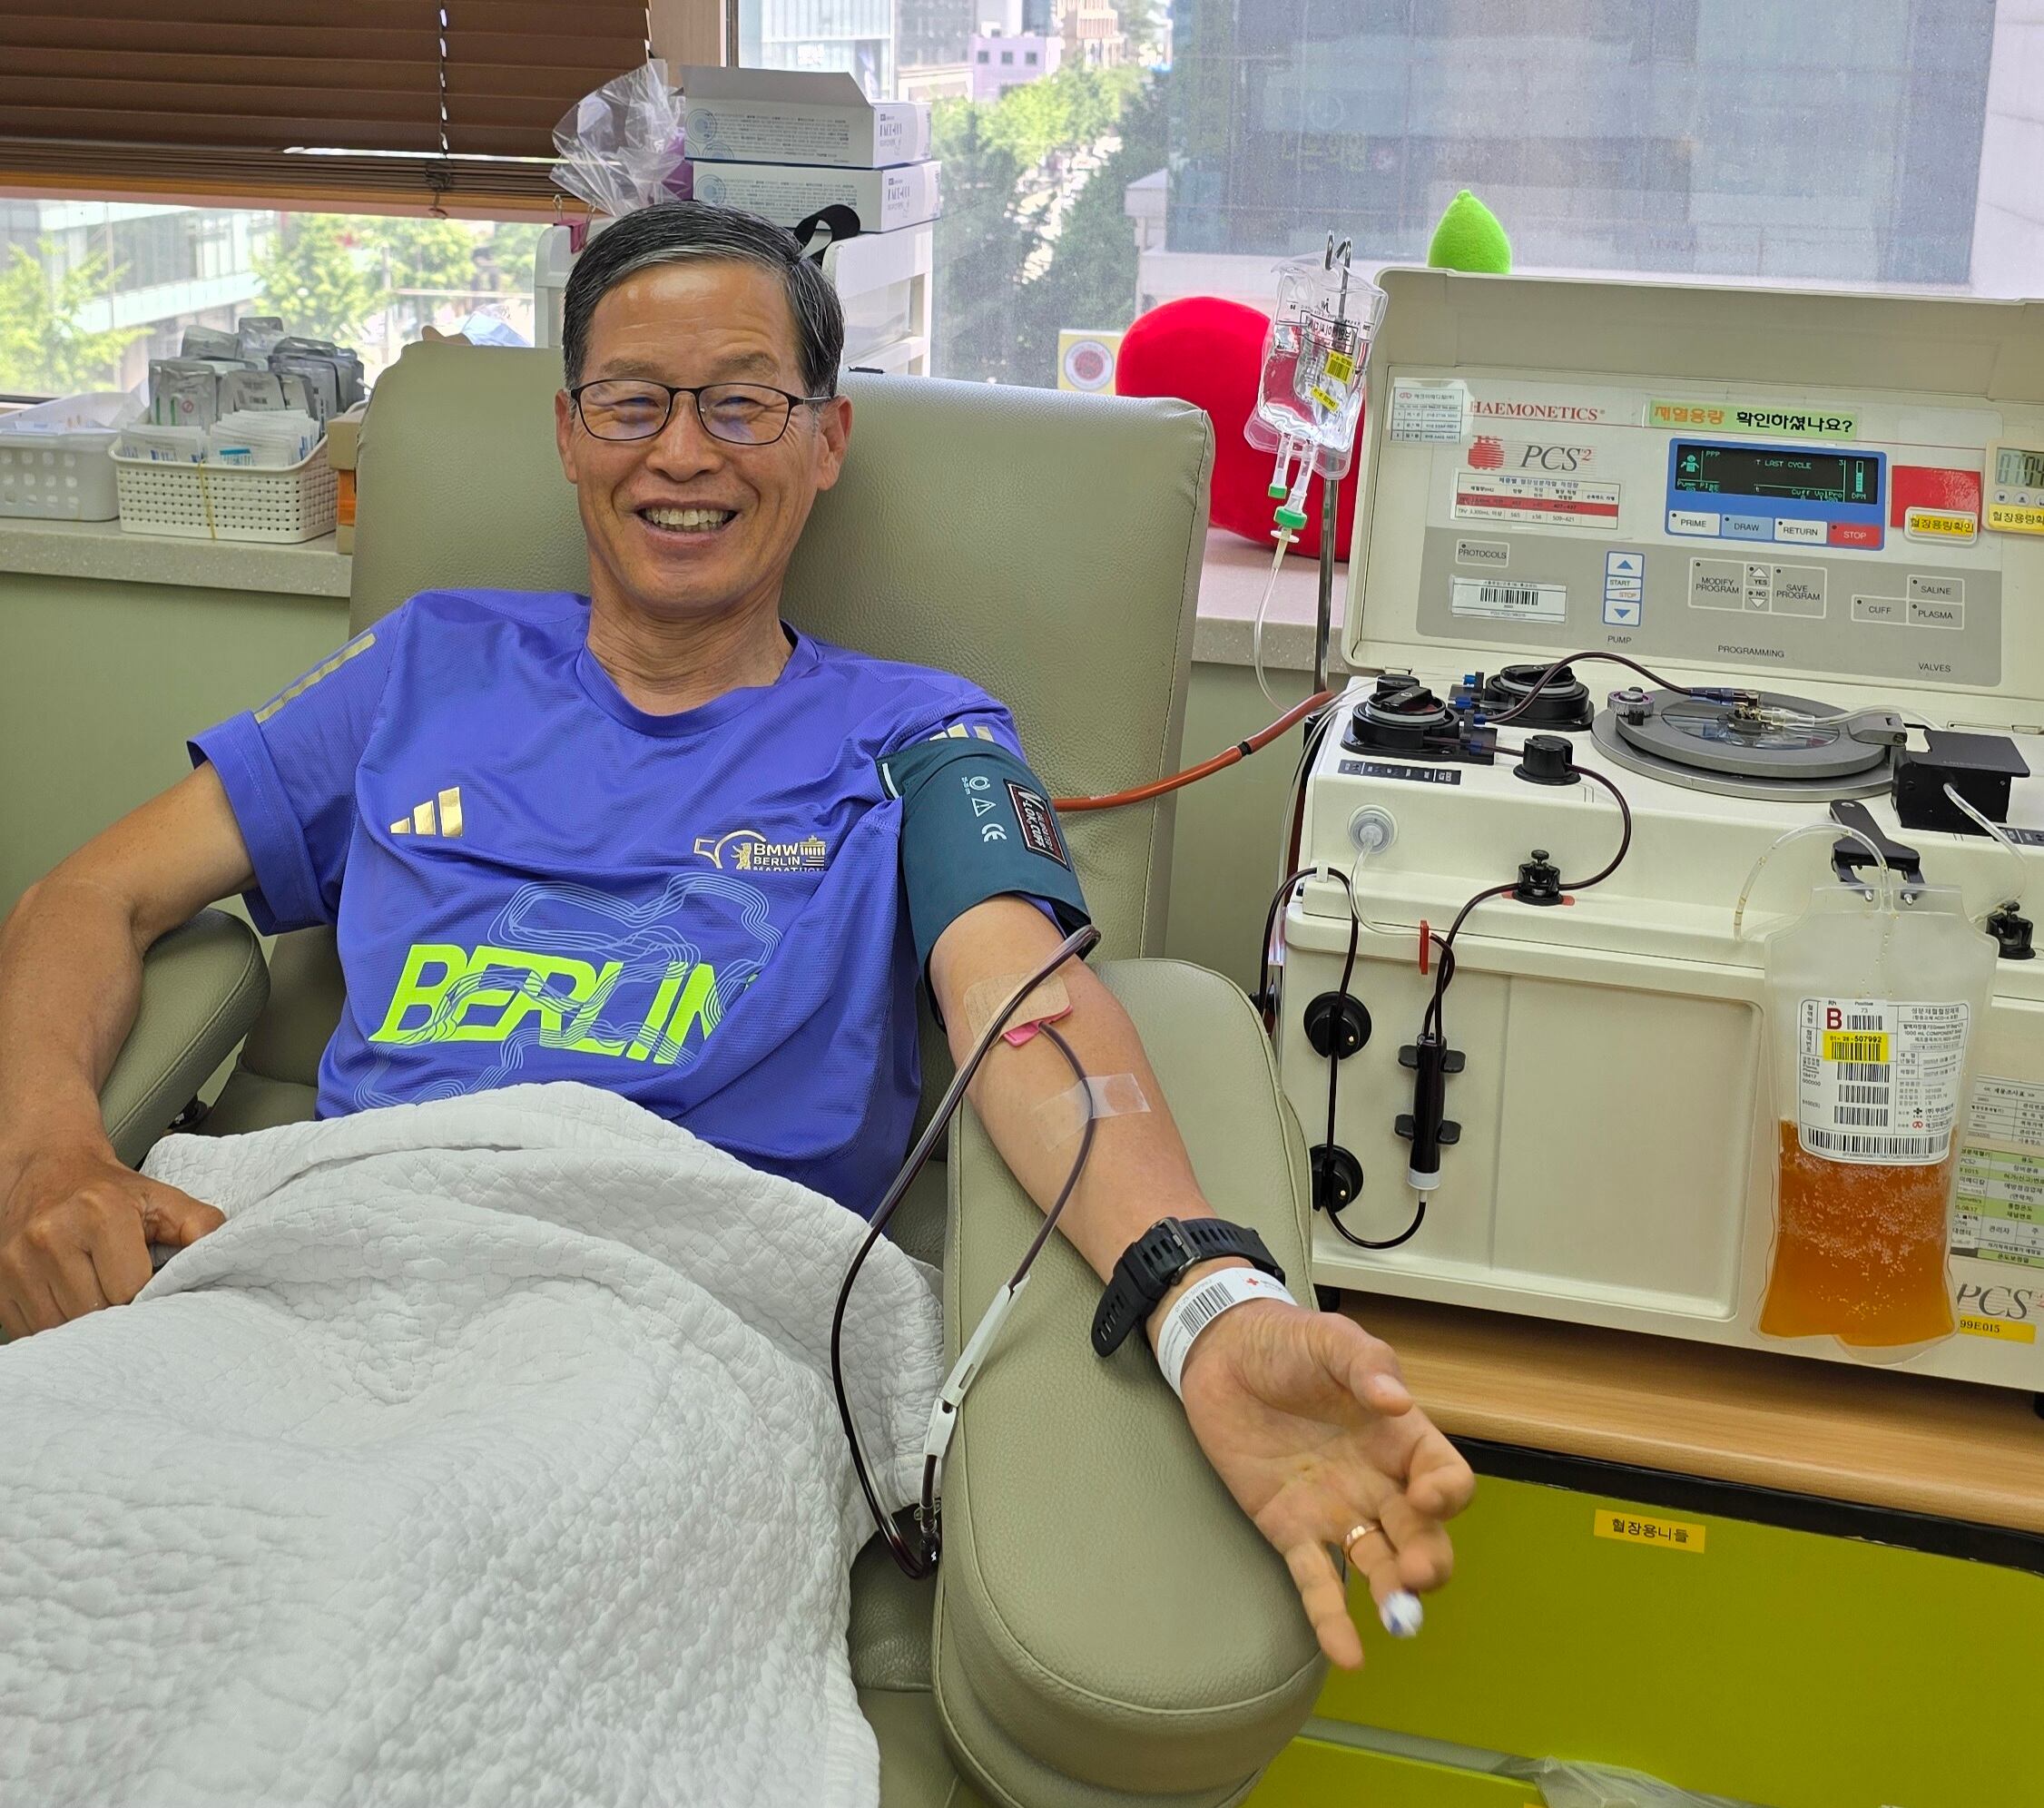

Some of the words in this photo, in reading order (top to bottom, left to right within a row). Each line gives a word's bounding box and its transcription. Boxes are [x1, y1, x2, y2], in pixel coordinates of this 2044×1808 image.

[1735, 410, 1853, 433] 확인하셨나요?
[1764, 459, 1784, 467] LAST
[1680, 517, 1707, 528] PRIME
[1734, 521, 1760, 532] DRAW
[1911, 517, 1974, 534] 혈장용량확인
[1783, 526, 1818, 537] RETURN
[1843, 530, 1867, 540] STOP
[1458, 548, 1507, 560] PROTOCOLS
[1701, 576, 1734, 586] MODIFY
[1695, 584, 1739, 594] PROGRAM
[1786, 584, 1808, 592] SAVE
[1921, 585, 1951, 595] SALINE
[1776, 591, 1820, 601] PROGRAM
[1869, 605, 1892, 614] CUFF
[1918, 610, 1953, 620] PLASMA
[1607, 635, 1632, 644] PUMP
[1718, 645, 1784, 658] PROGRAMMING
[1918, 663, 1951, 673] VALVES
[753, 842, 799, 856] BMW
[753, 856, 801, 866] BERLIN
[1826, 1007, 1843, 1030] B
[1612, 1518, 1689, 1543] 혈장용니들
